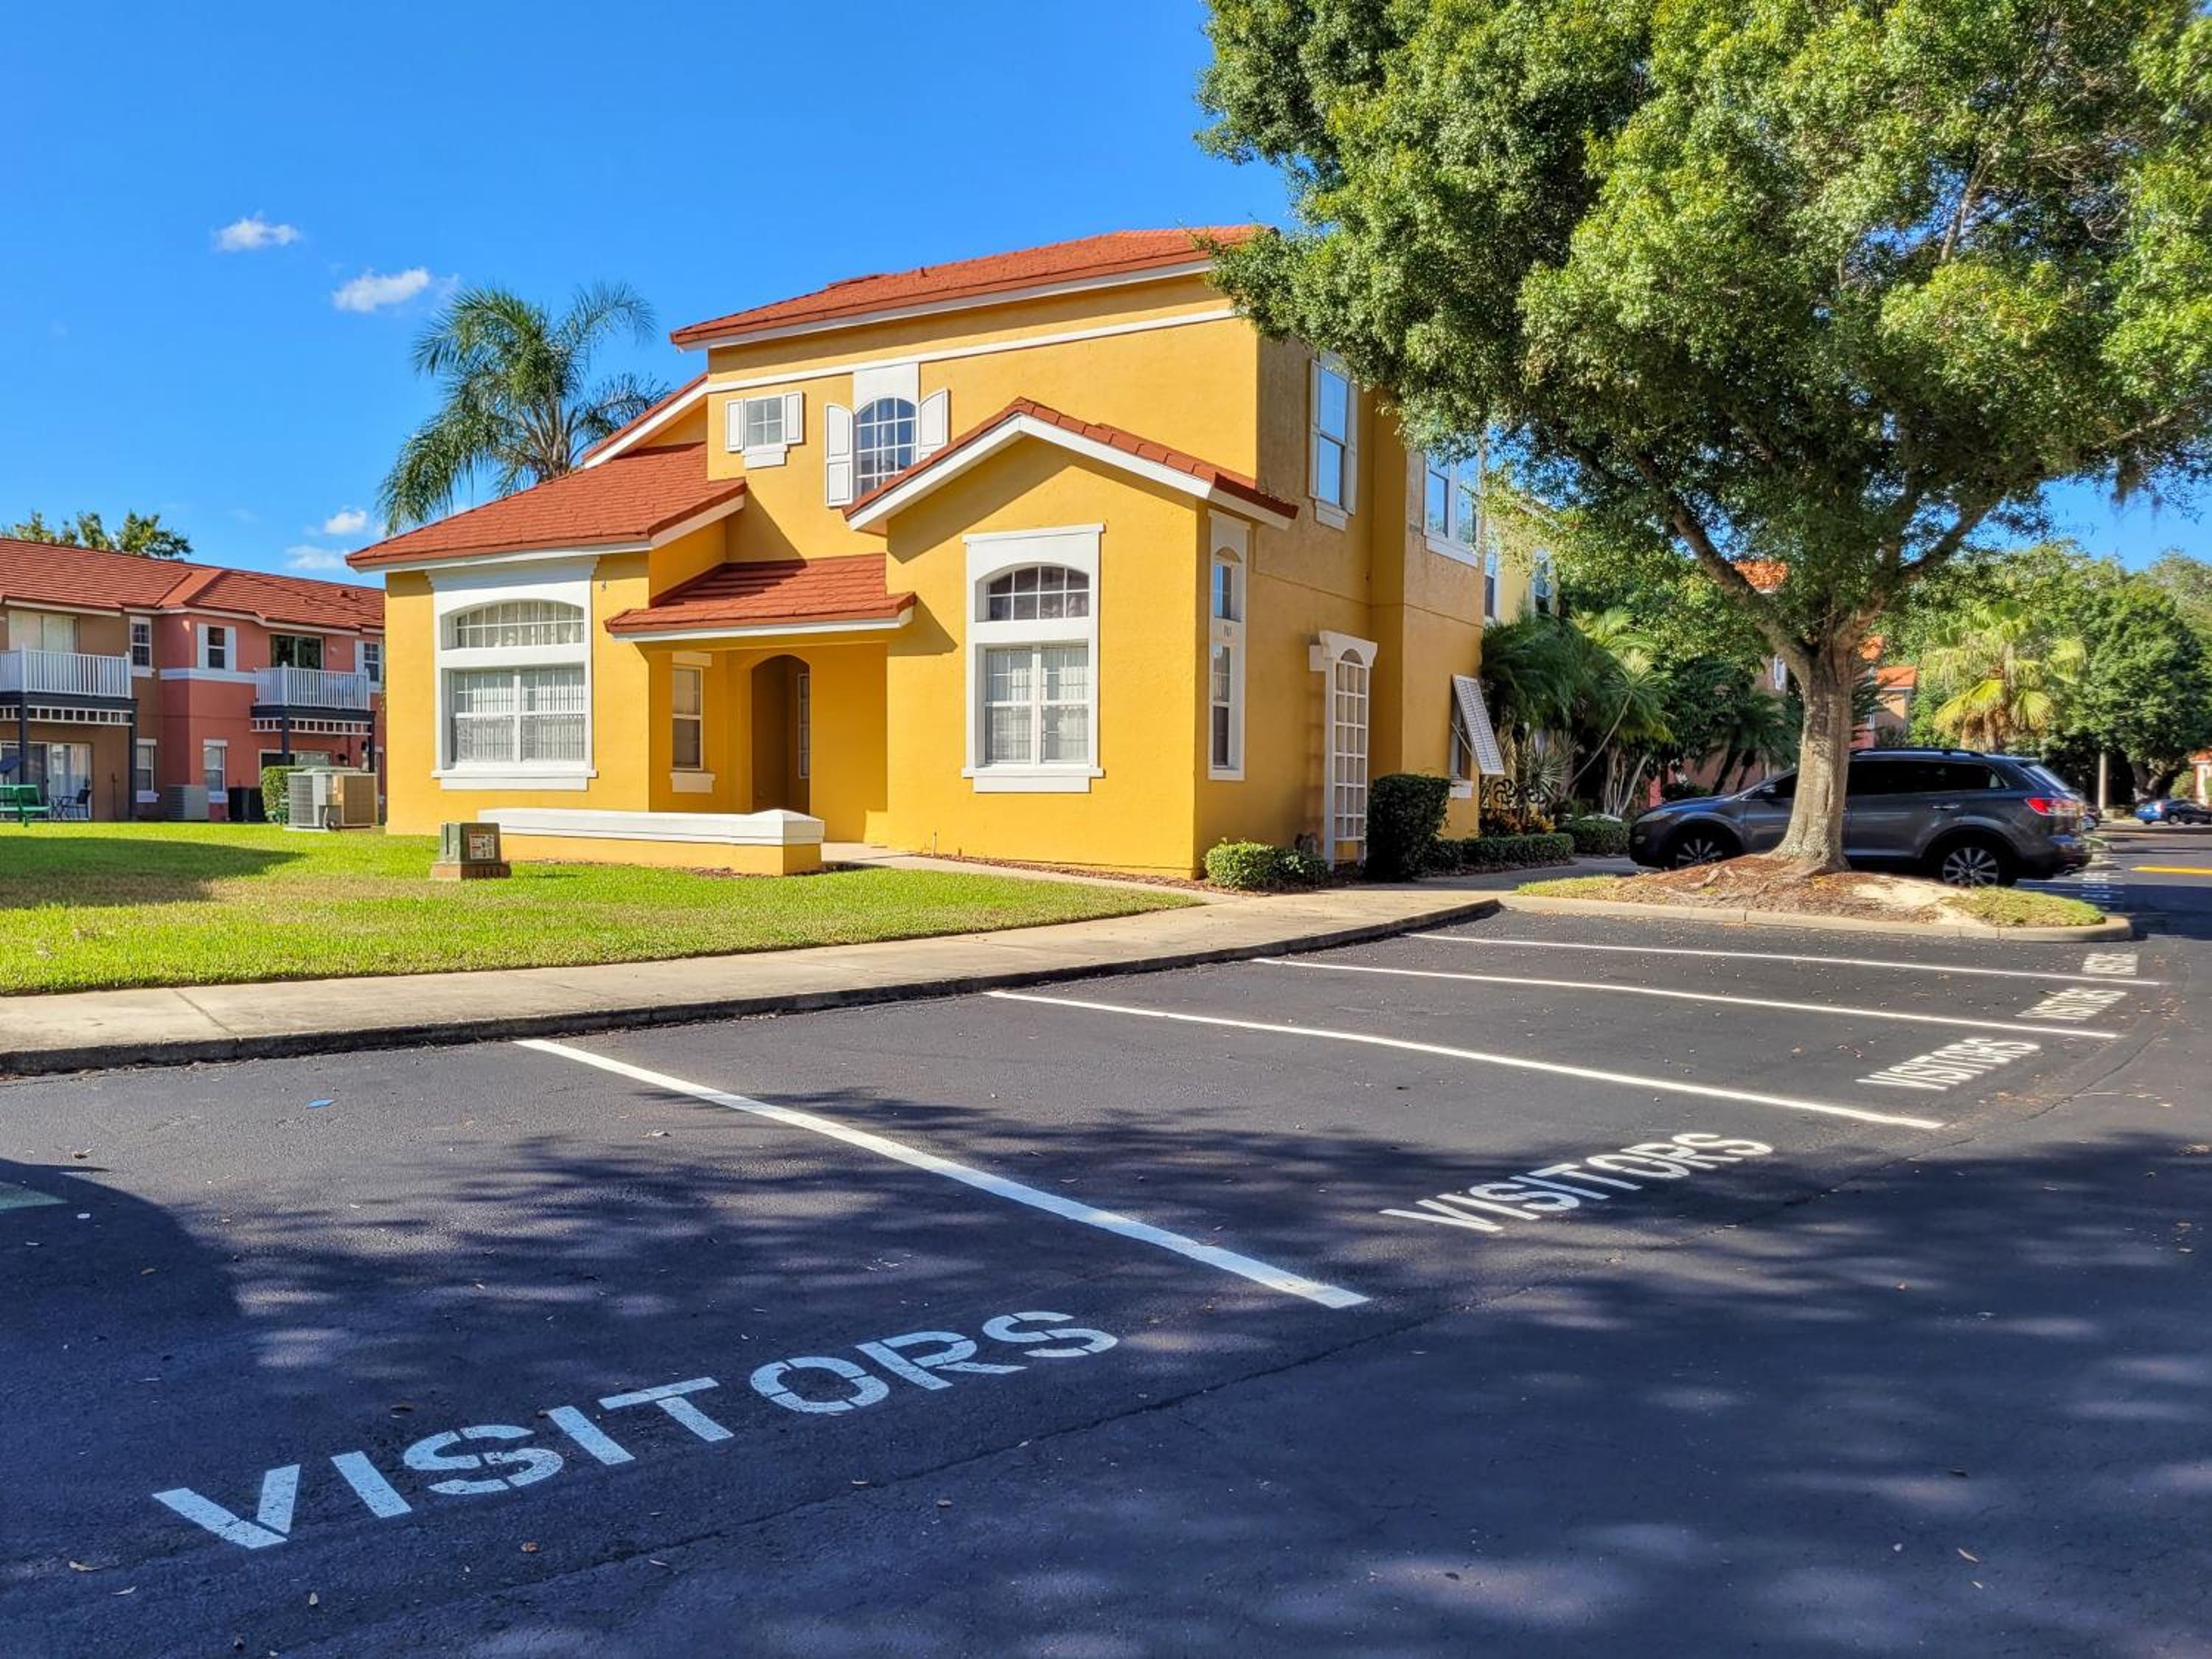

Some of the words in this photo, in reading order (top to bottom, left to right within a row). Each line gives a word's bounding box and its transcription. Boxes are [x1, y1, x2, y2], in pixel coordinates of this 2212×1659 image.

[1855, 1037, 2041, 1091] VISITORS
[1380, 1133, 1773, 1232] VISITORS
[152, 1310, 1119, 1549] VISITORS
